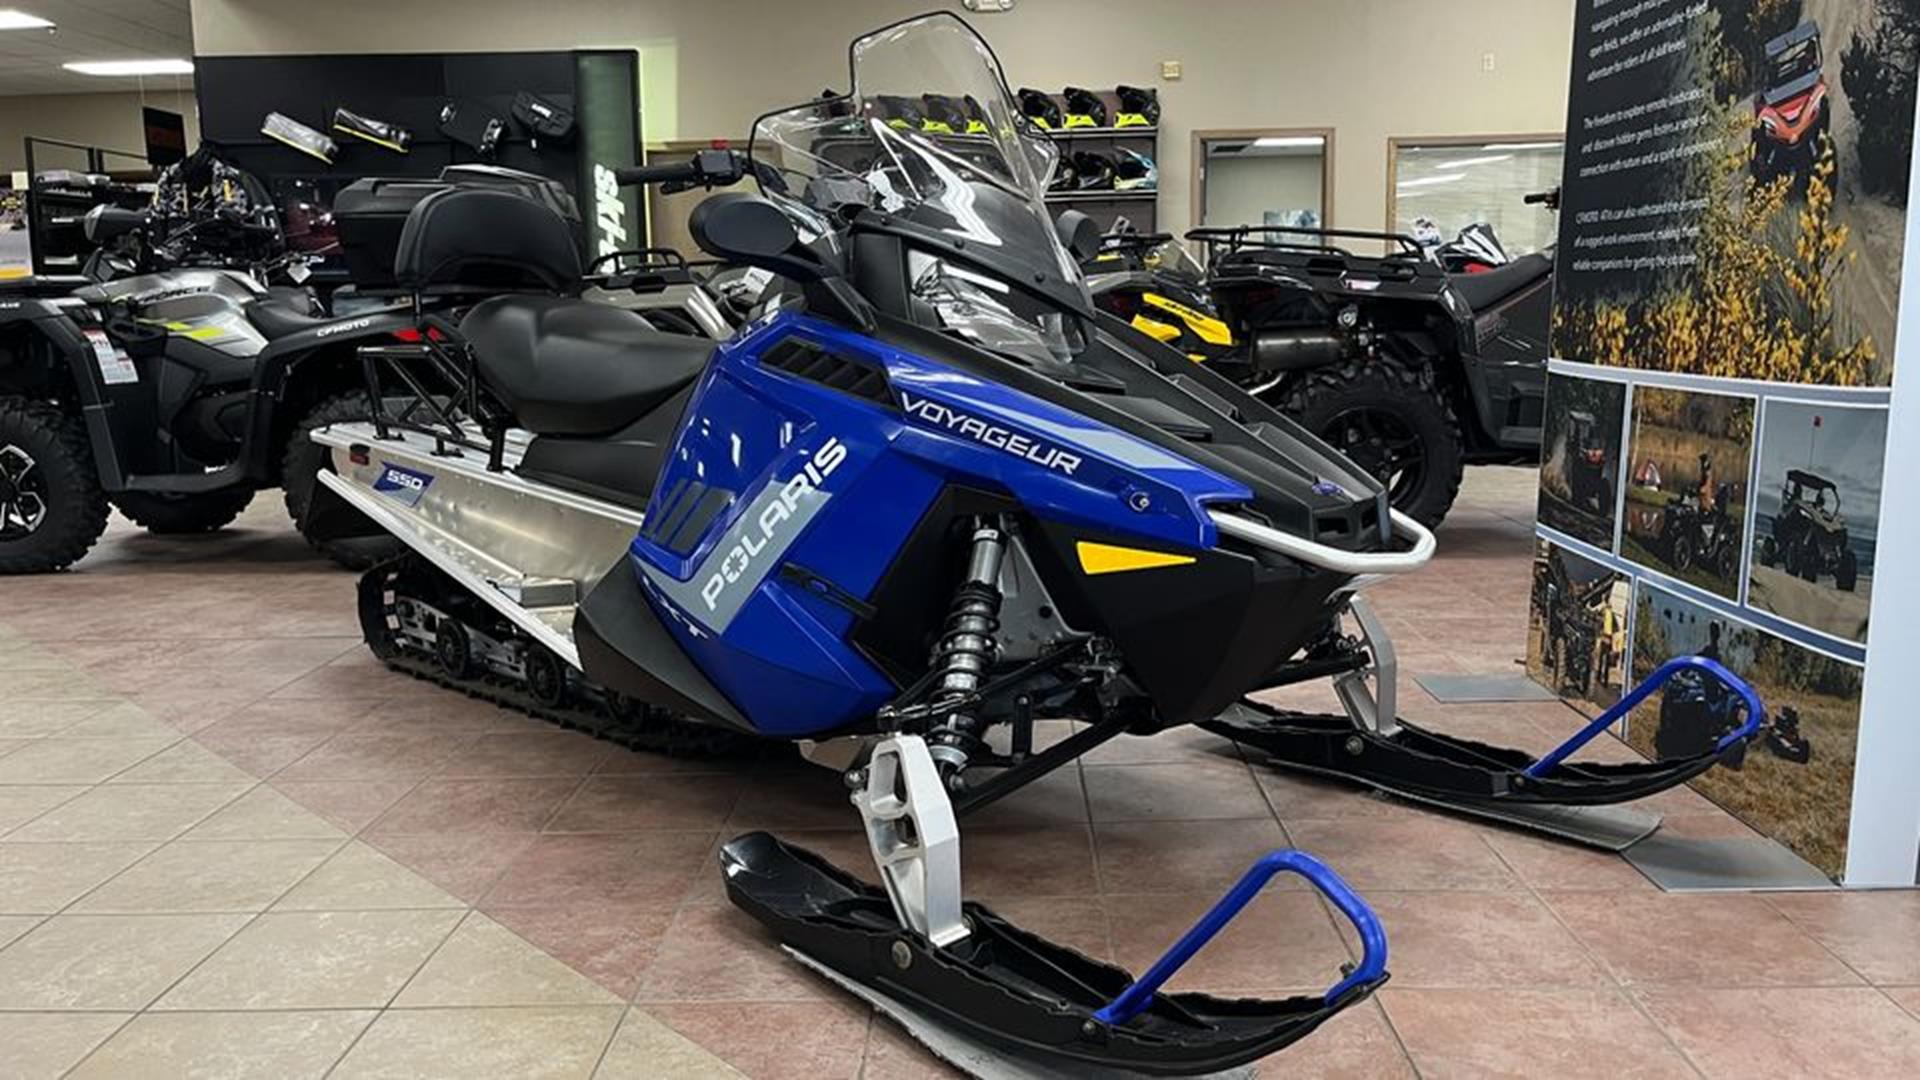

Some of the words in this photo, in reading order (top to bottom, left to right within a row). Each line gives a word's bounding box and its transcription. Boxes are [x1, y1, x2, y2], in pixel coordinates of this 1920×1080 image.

[594, 163, 627, 274] SKI-D
[141, 286, 211, 302] FORCE
[317, 319, 370, 337] CFMOTO
[901, 392, 1082, 475] VOYAGEUR
[386, 469, 424, 490] 550
[701, 436, 848, 612] POLARIS
